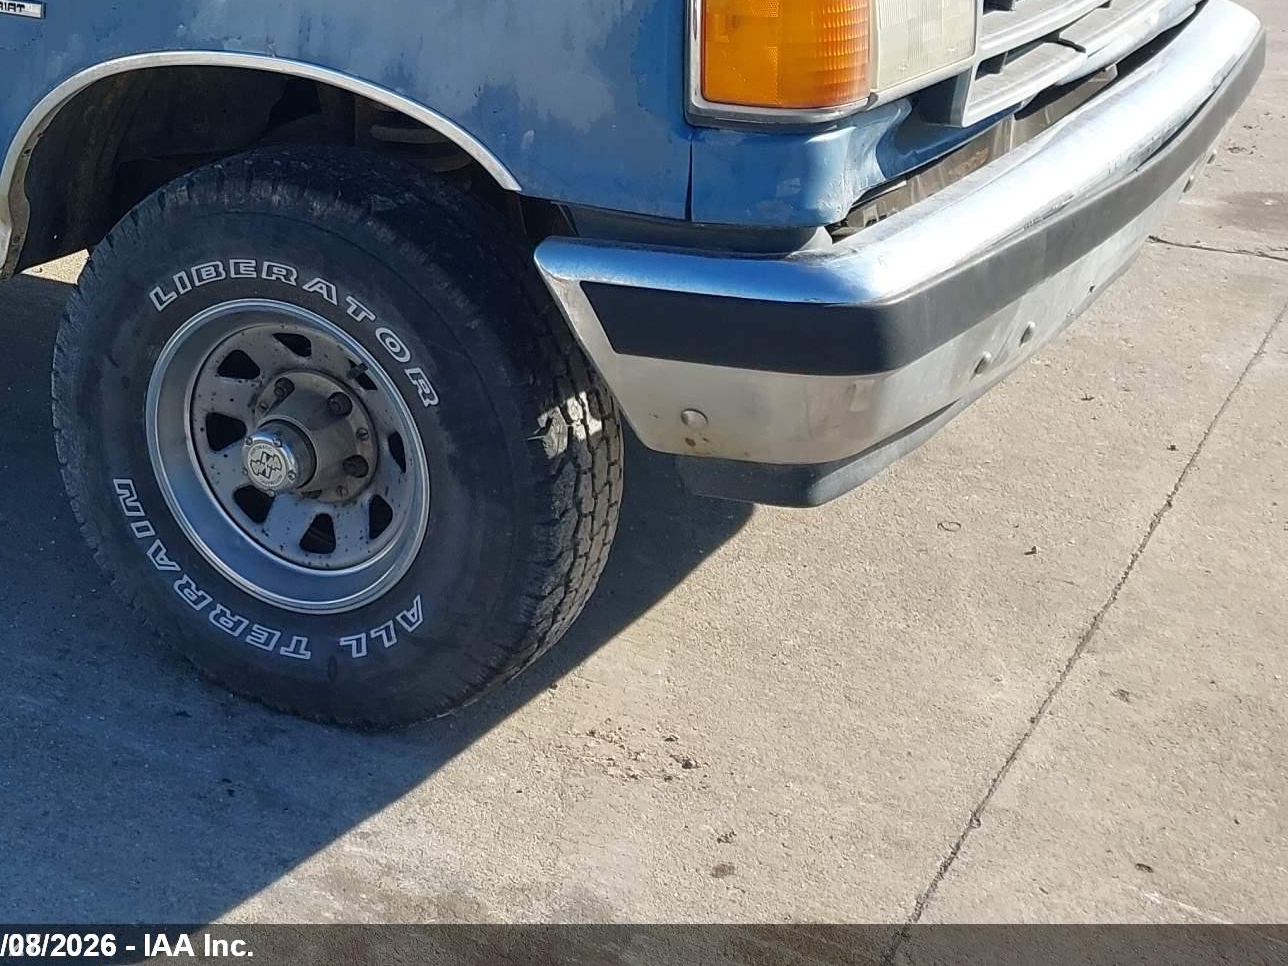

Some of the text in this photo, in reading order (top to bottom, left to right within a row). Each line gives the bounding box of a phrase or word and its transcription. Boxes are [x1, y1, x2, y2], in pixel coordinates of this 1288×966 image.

[148, 257, 441, 409] LIBERATOR
[113, 477, 426, 661] ALL TERRAIN
